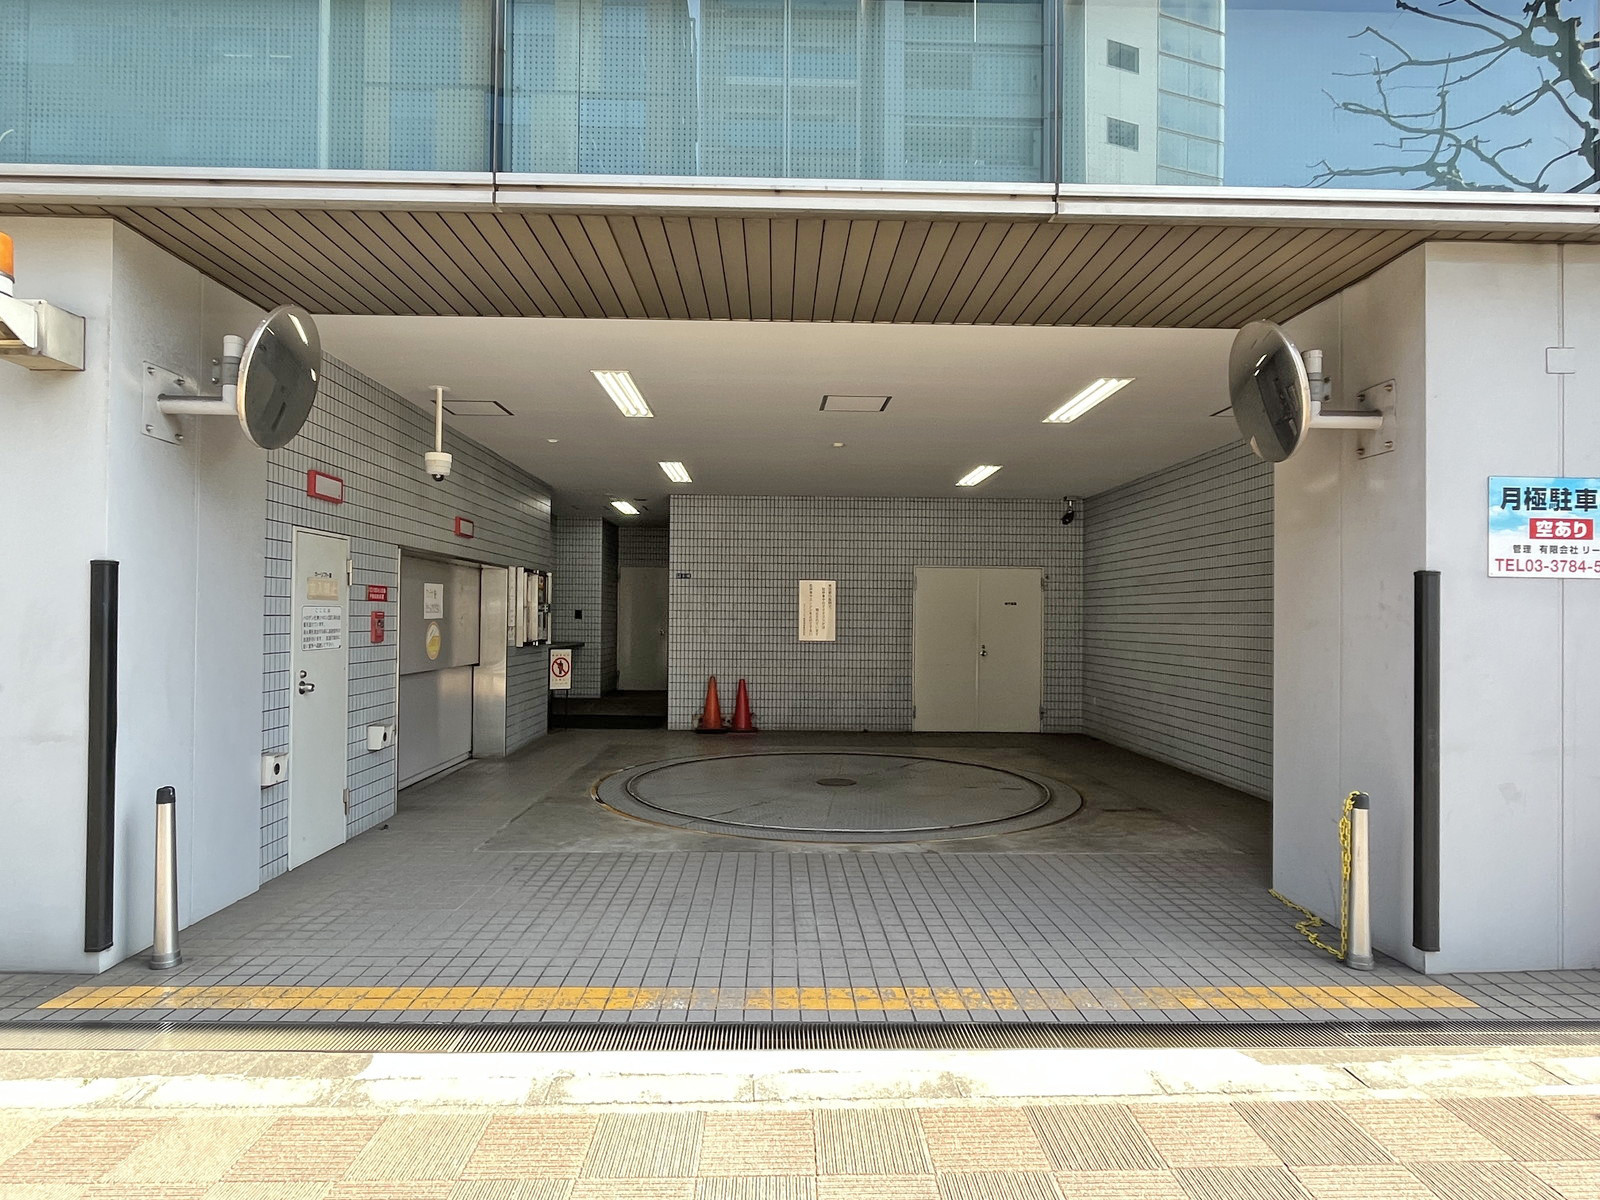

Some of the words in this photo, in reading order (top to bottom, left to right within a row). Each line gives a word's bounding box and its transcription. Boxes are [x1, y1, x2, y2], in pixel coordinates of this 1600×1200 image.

[1500, 487, 1598, 512] 月極駐車
[1535, 520, 1587, 538] 空あり
[1513, 544, 1532, 554] 管理
[1495, 558, 1600, 573] TEL03-3784-5
